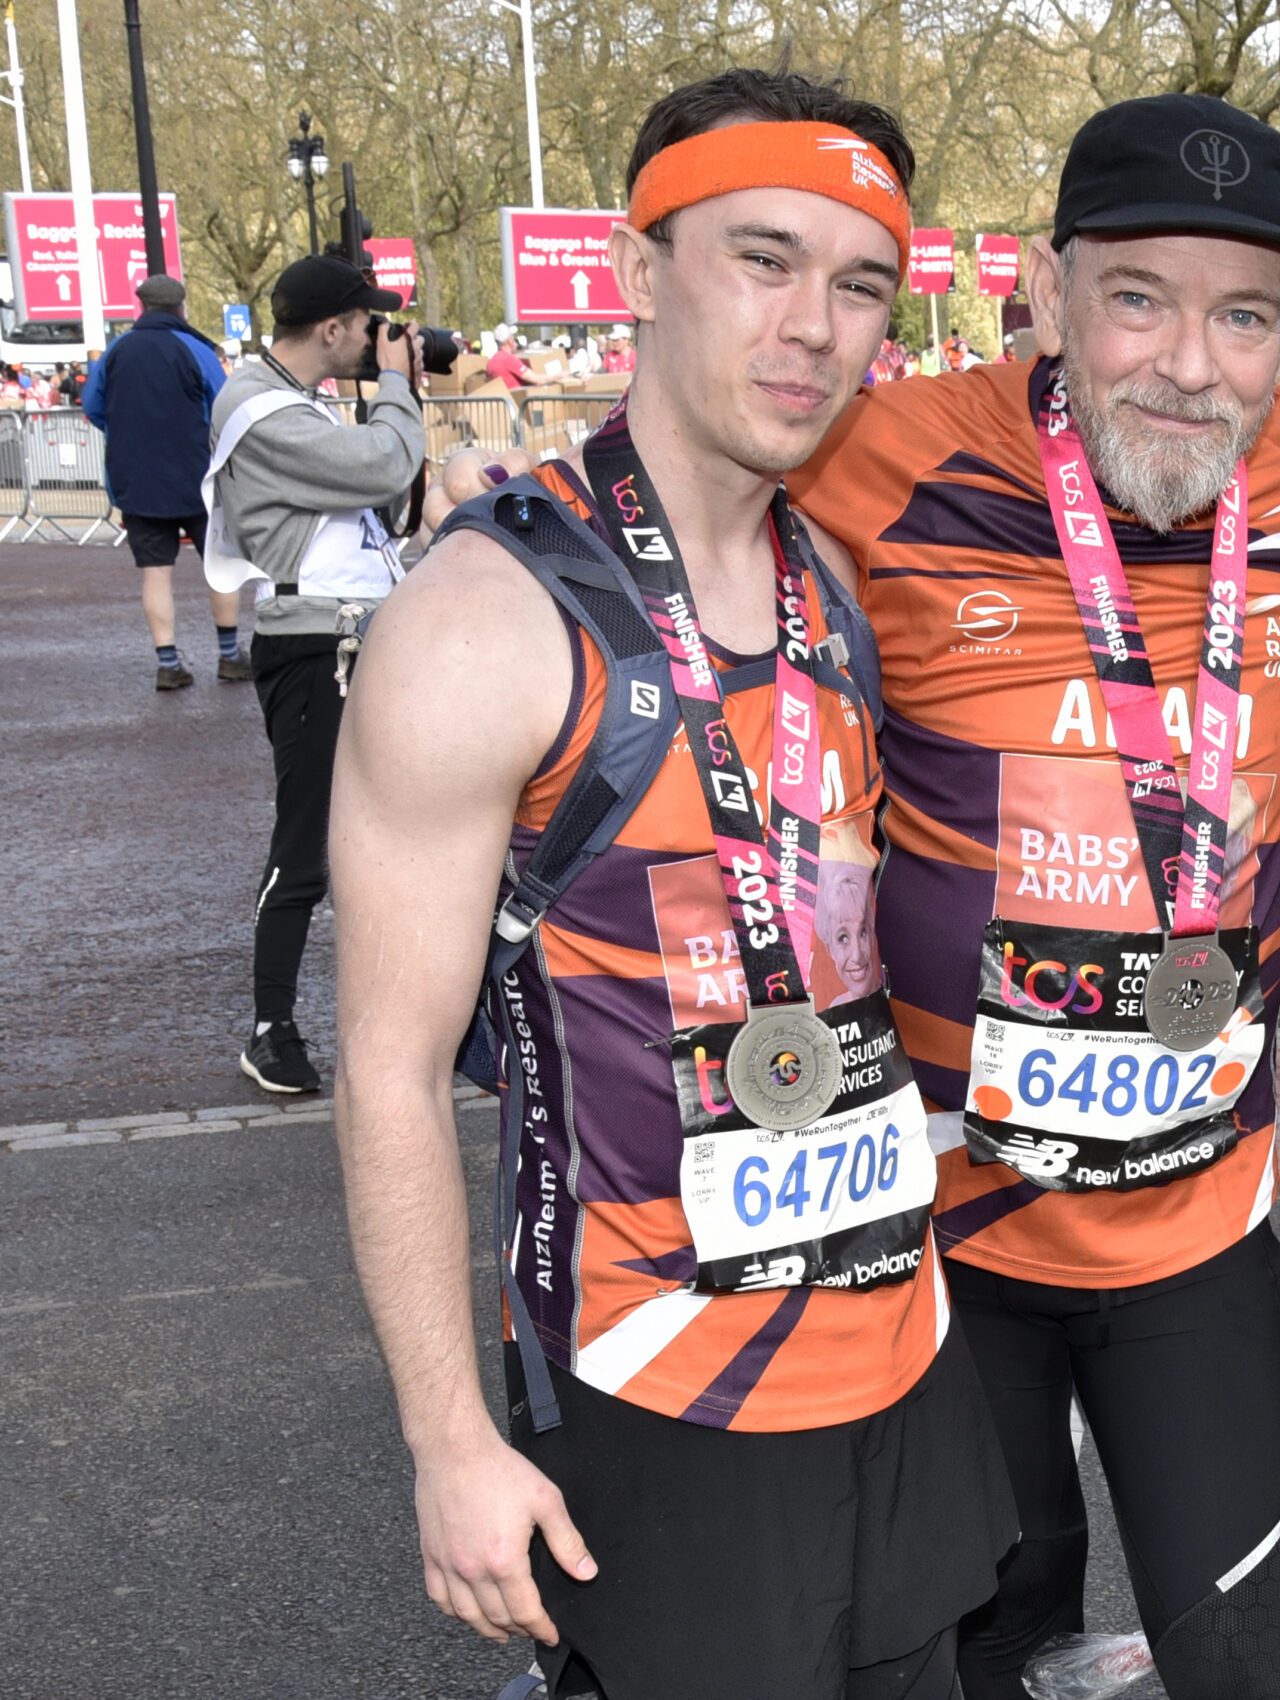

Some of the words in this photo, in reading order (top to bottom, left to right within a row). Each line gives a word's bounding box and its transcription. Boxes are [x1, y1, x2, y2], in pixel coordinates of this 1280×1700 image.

[852, 172, 869, 190] UK
[519, 253, 546, 266] Blue
[561, 253, 599, 267] Green
[524, 235, 582, 252] Baggage
[611, 473, 644, 523] tcs
[1058, 460, 1084, 506] tcs
[1216, 515, 1236, 555] tcs
[1089, 574, 1129, 664] FINISHER
[1207, 580, 1238, 670] 2023
[664, 592, 712, 688] FINISHER
[948, 644, 1023, 656] SCIMITAR
[843, 709, 860, 727] UK
[1051, 679, 1253, 760] AA
[703, 718, 732, 766] tcs
[779, 743, 806, 785] tcs
[1133, 759, 1164, 776] 2023
[1154, 775, 1177, 790] tcs
[1196, 750, 1220, 791] tcs
[780, 816, 800, 911] FINISHER
[1190, 821, 1212, 910] FINISHER
[731, 850, 780, 950] 2023
[1015, 865, 1139, 907] ARMY
[684, 929, 741, 970] BA
[696, 970, 750, 1008] AR
[763, 969, 790, 1001] tc
[1002, 941, 1105, 1016] tcs
[502, 970, 545, 1098] Researc
[984, 1043, 1004, 1054] WAVE
[1084, 1034, 1161, 1045] #WeRunTogethe
[836, 1063, 883, 1097] RVICES
[979, 1059, 1003, 1071] LORRY
[1017, 1048, 1217, 1117] 64802
[794, 1115, 862, 1138] #WeRunTogether
[732, 1122, 901, 1227] 64706
[1075, 1164, 1120, 1186] new
[1125, 1141, 1215, 1181] balance
[853, 1245, 925, 1285] balanc
